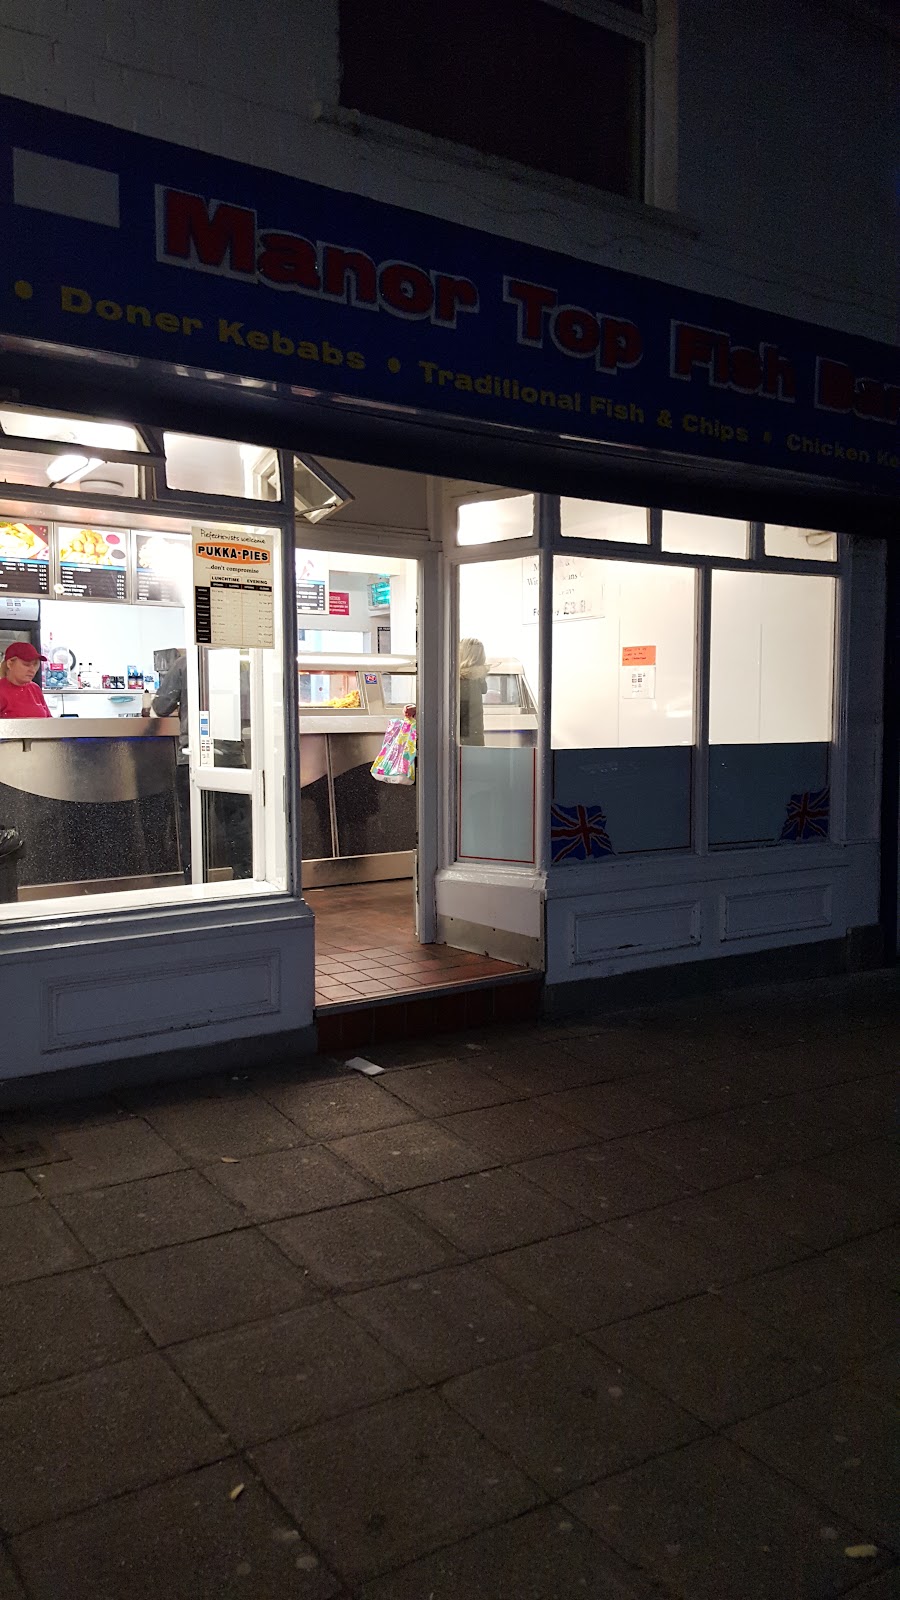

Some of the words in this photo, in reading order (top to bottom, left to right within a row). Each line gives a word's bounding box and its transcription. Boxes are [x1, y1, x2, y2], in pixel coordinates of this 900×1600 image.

[60, 286, 204, 337] Doner
[218, 318, 366, 370] Kebabs
[418, 360, 581, 412] Traditional
[589, 395, 645, 424] Fish
[656, 409, 673, 429] &
[681, 414, 750, 444] Chips
[785, 433, 870, 463] Chicken
[155, 184, 480, 329] Manor
[502, 275, 643, 375] Top
[669, 318, 797, 404] Fish
[241, 536, 266, 544] welcome
